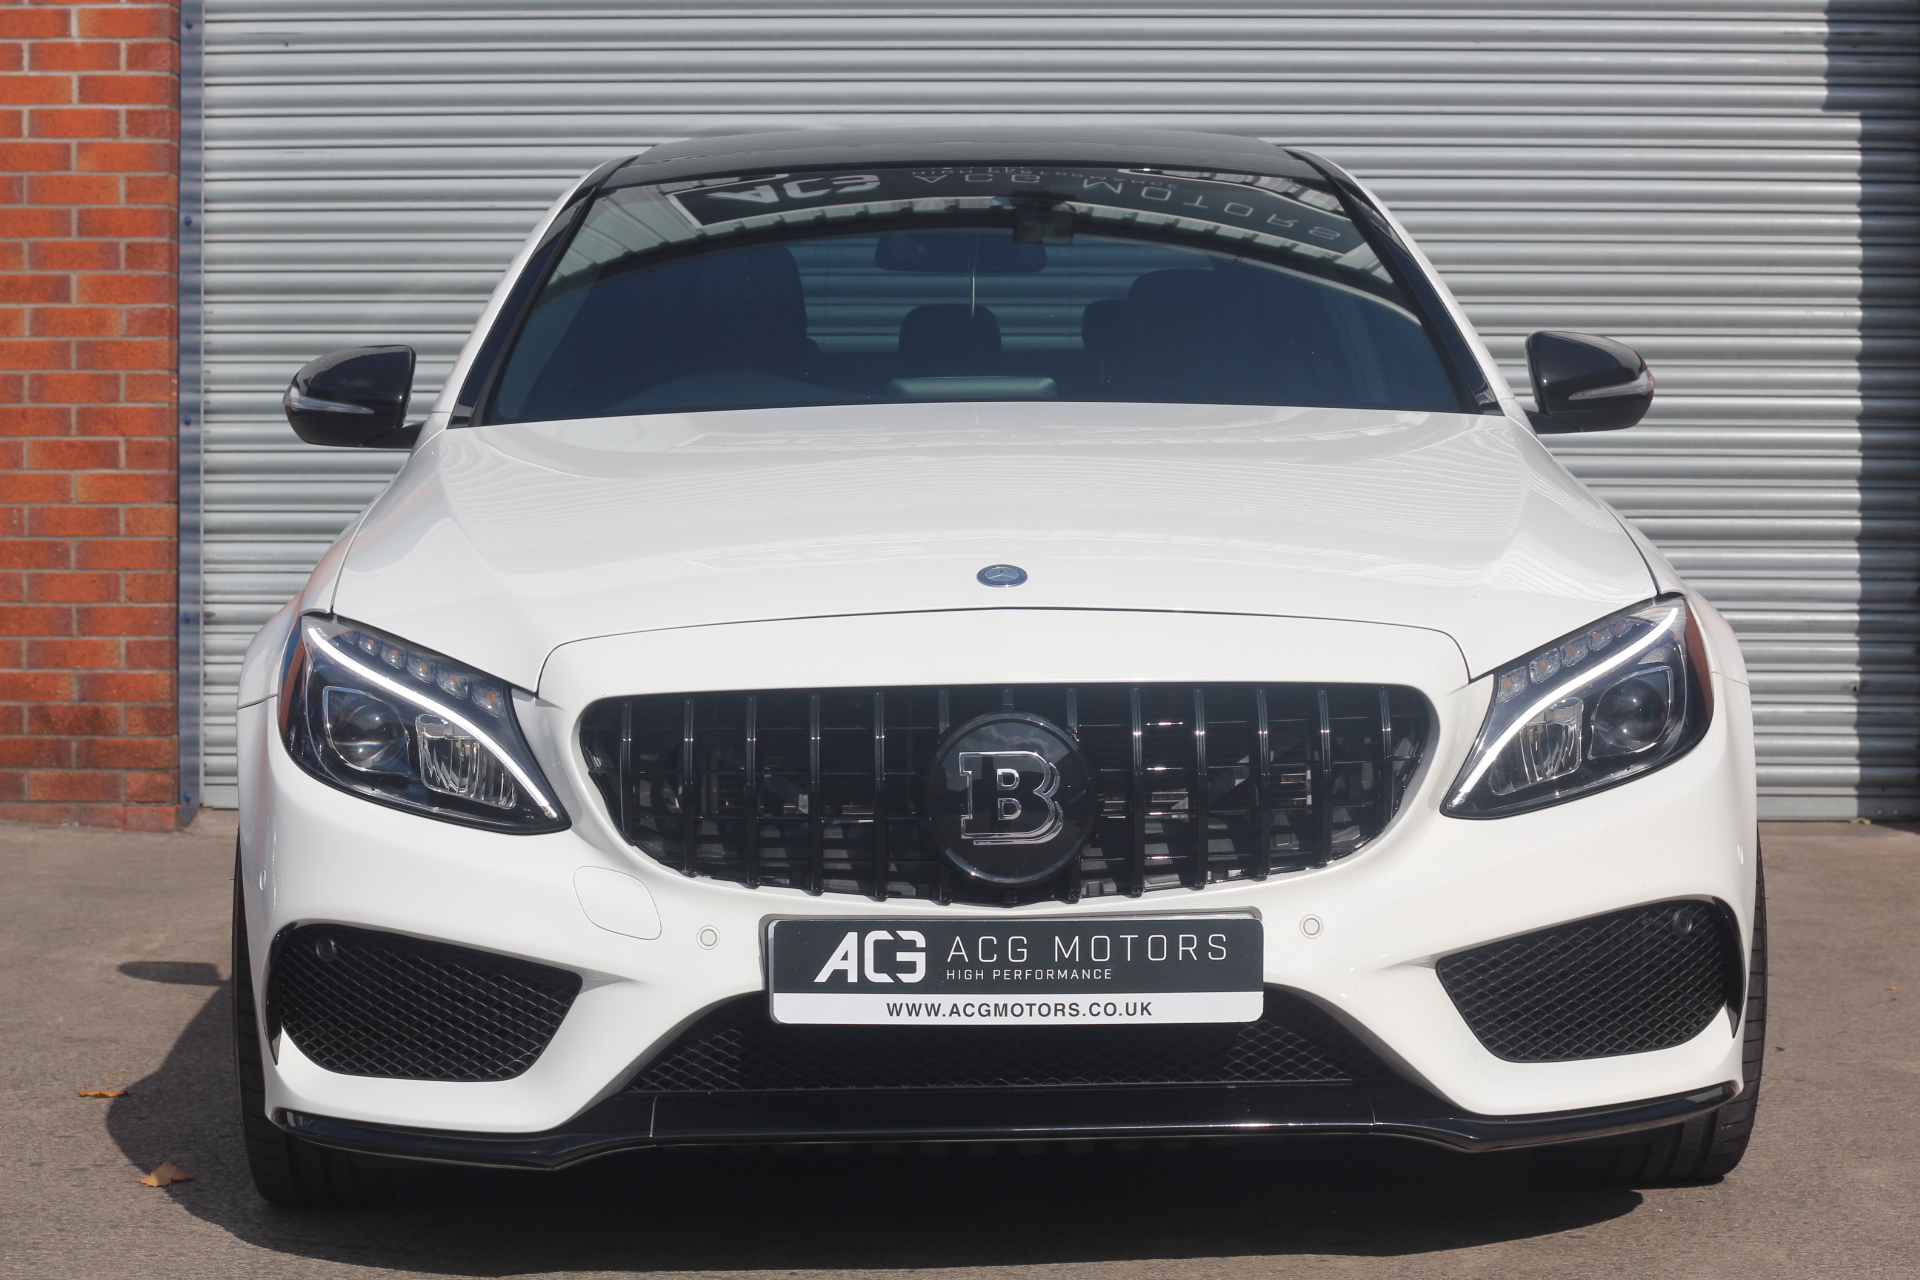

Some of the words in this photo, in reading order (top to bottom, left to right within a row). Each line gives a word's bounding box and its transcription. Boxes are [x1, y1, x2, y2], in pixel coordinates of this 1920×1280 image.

[959, 751, 1064, 846] B
[813, 930, 927, 984] ACG
[946, 935, 1029, 963] ACG
[1054, 932, 1230, 963] MOTORS
[945, 968, 985, 981] HIGH
[991, 968, 1113, 981] PERFORMANCE
[885, 1001, 1153, 1019] WWW.ACGMOTORS.CO.UK
